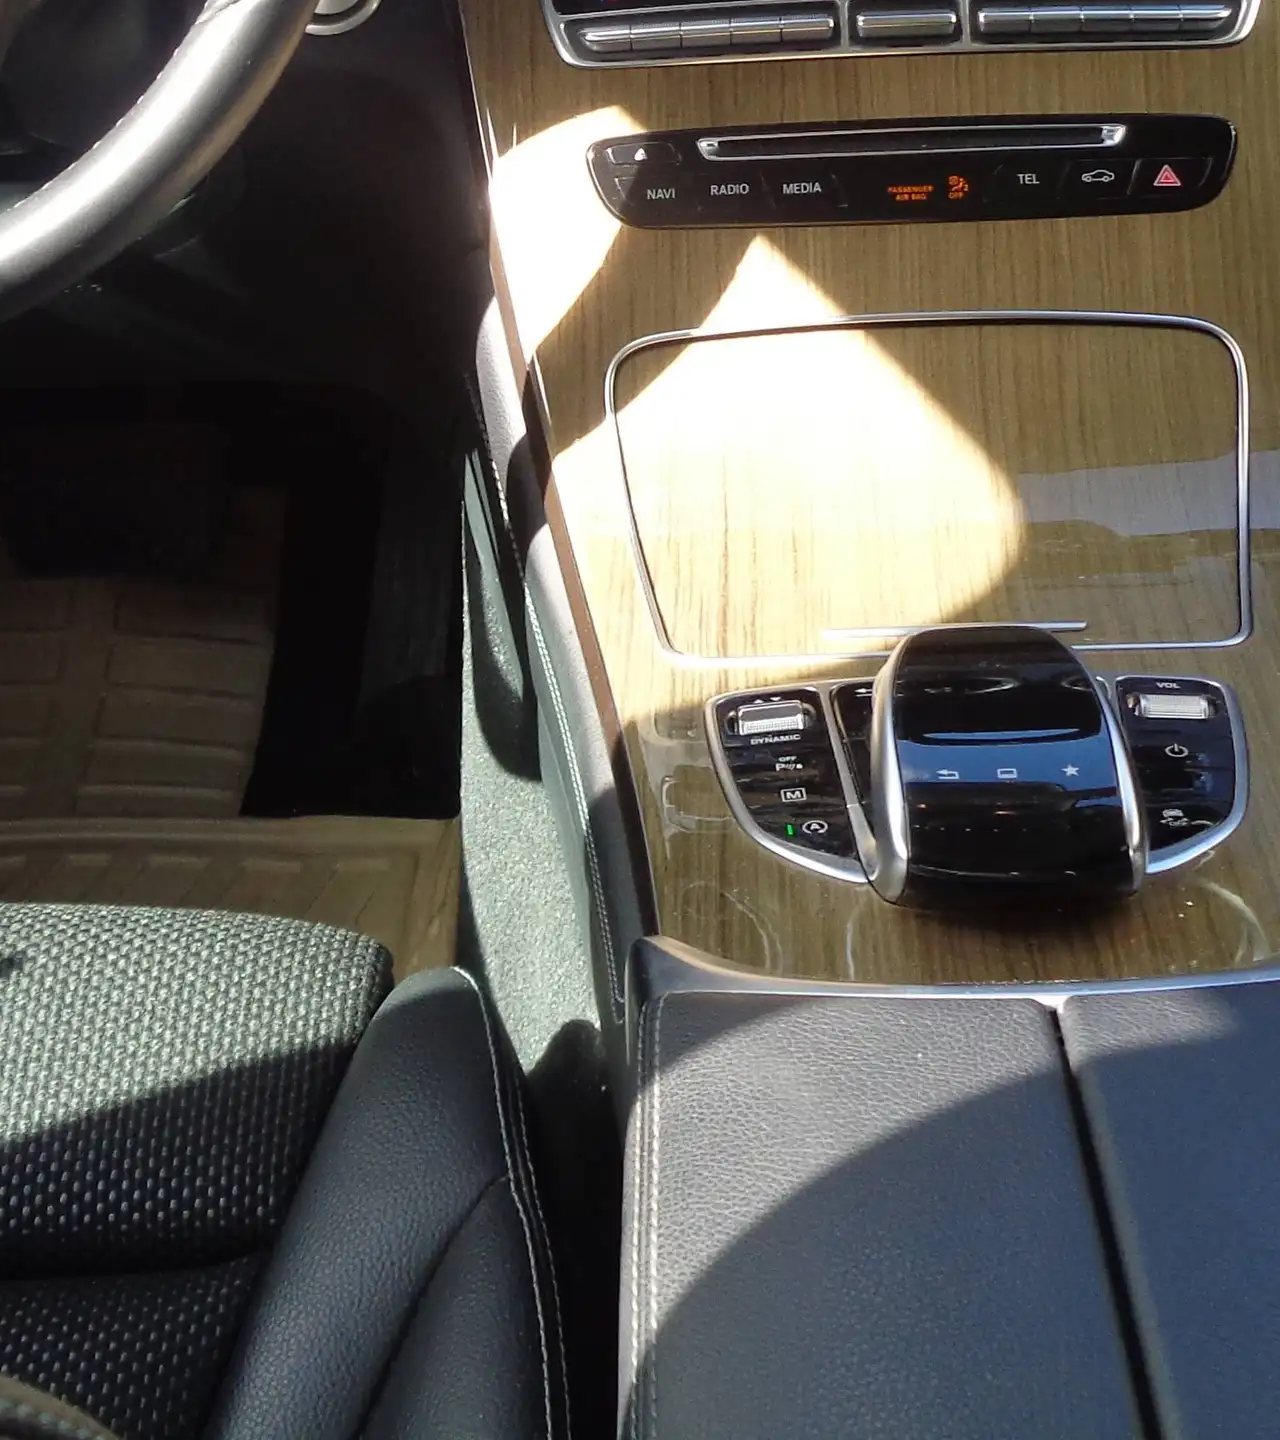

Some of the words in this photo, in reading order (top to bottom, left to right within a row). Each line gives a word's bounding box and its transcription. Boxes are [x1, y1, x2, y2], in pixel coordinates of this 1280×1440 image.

[1016, 173, 1040, 185] TEL
[646, 188, 676, 200] NAVI
[710, 183, 750, 196] RADIO
[782, 181, 822, 195] MEDIA
[887, 185, 934, 193] PASSENGER
[1156, 681, 1181, 689] VOL
[750, 733, 801, 745] DYNAMIC
